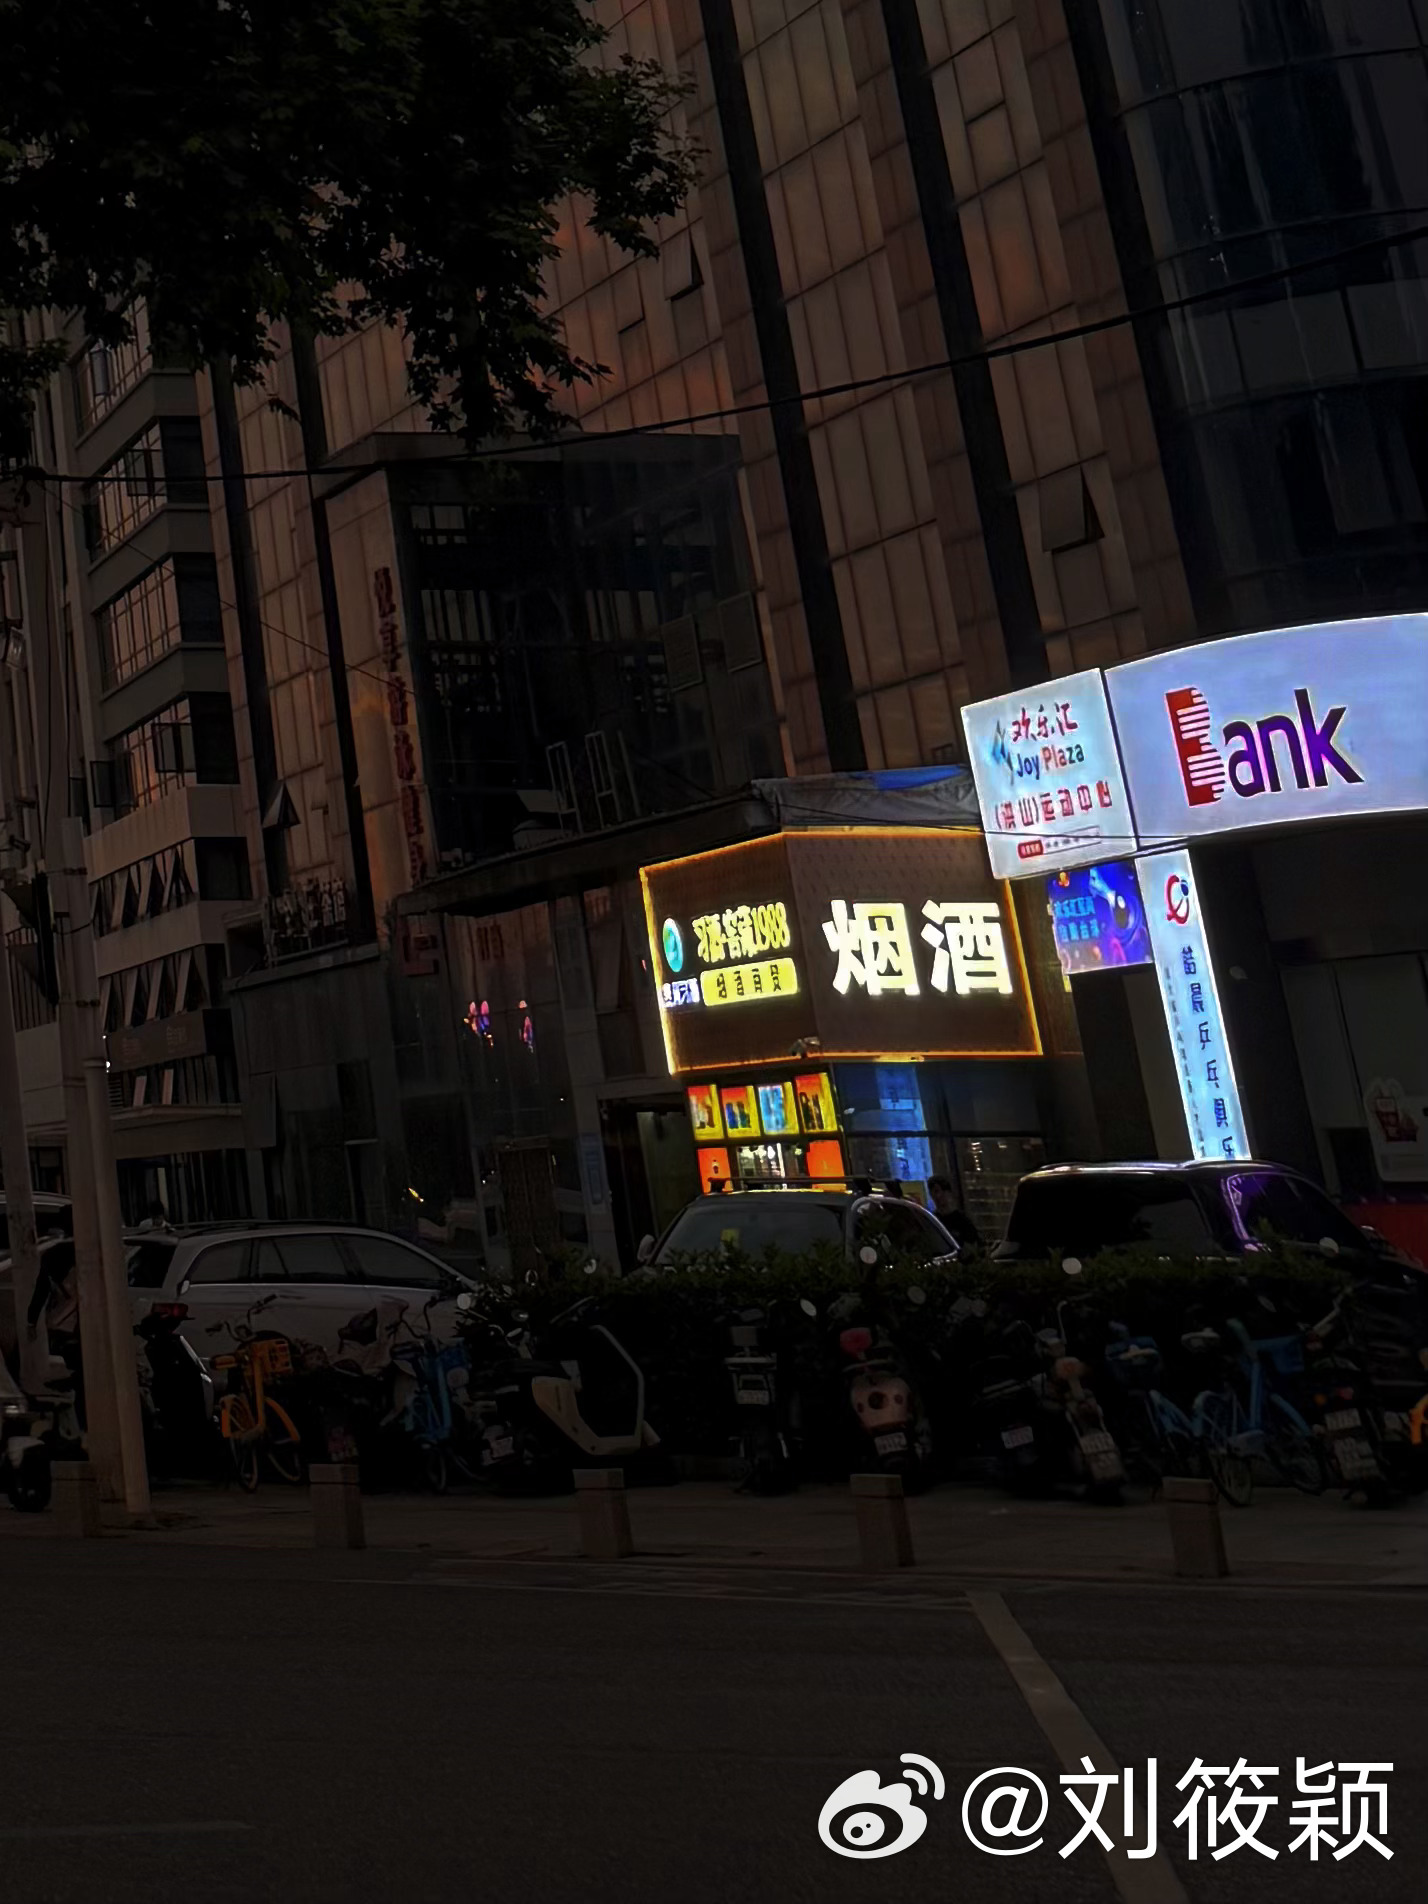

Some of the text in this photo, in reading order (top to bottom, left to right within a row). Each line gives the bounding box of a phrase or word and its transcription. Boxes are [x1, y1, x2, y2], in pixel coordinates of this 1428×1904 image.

[1011, 701, 1079, 743] 欢乐汇
[1016, 743, 1085, 780] Joy Plaza
[821, 899, 1013, 996] 烟酒
